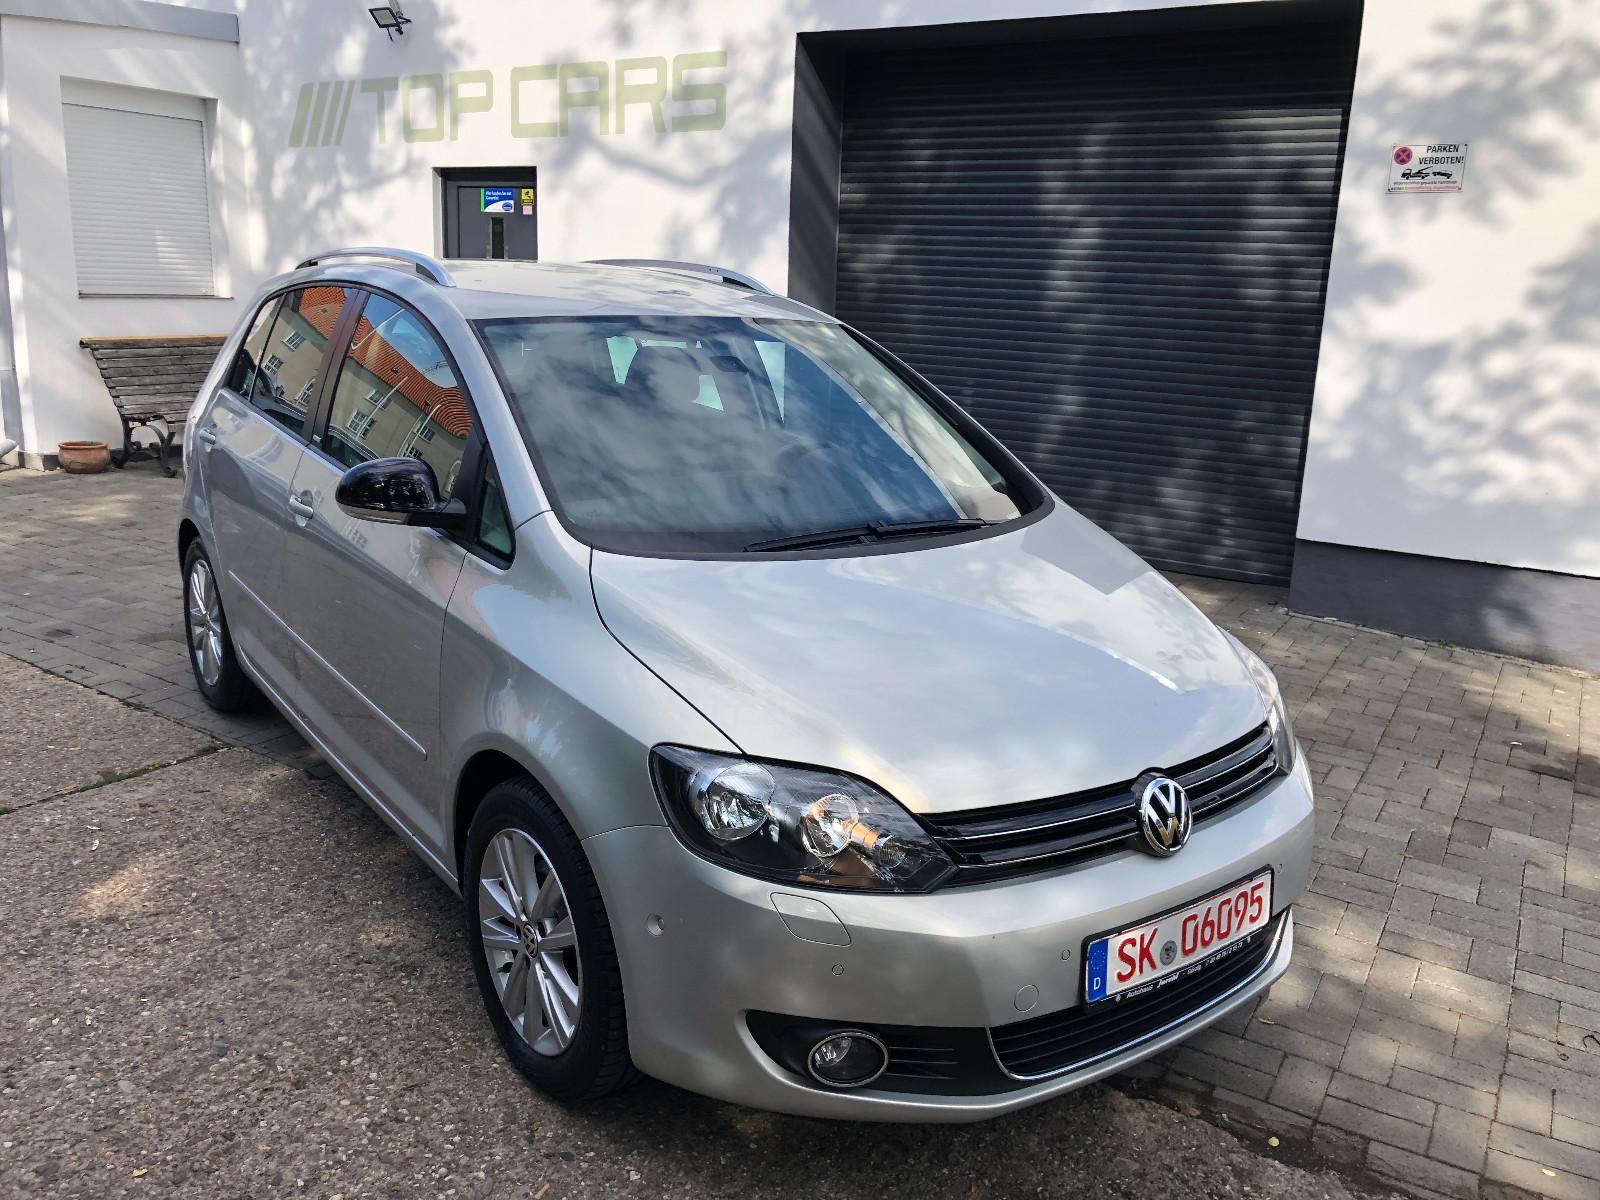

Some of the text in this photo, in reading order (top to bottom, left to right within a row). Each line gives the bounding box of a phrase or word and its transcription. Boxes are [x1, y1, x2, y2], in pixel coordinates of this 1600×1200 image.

[361, 51, 728, 145] TOP CARS
[1426, 144, 1460, 154] PARKEN
[1418, 156, 1465, 165] VERBOTEN!
[1116, 882, 1264, 983] SK 06095
[1093, 977, 1101, 991] D
[1126, 984, 1154, 999] Autohaus
